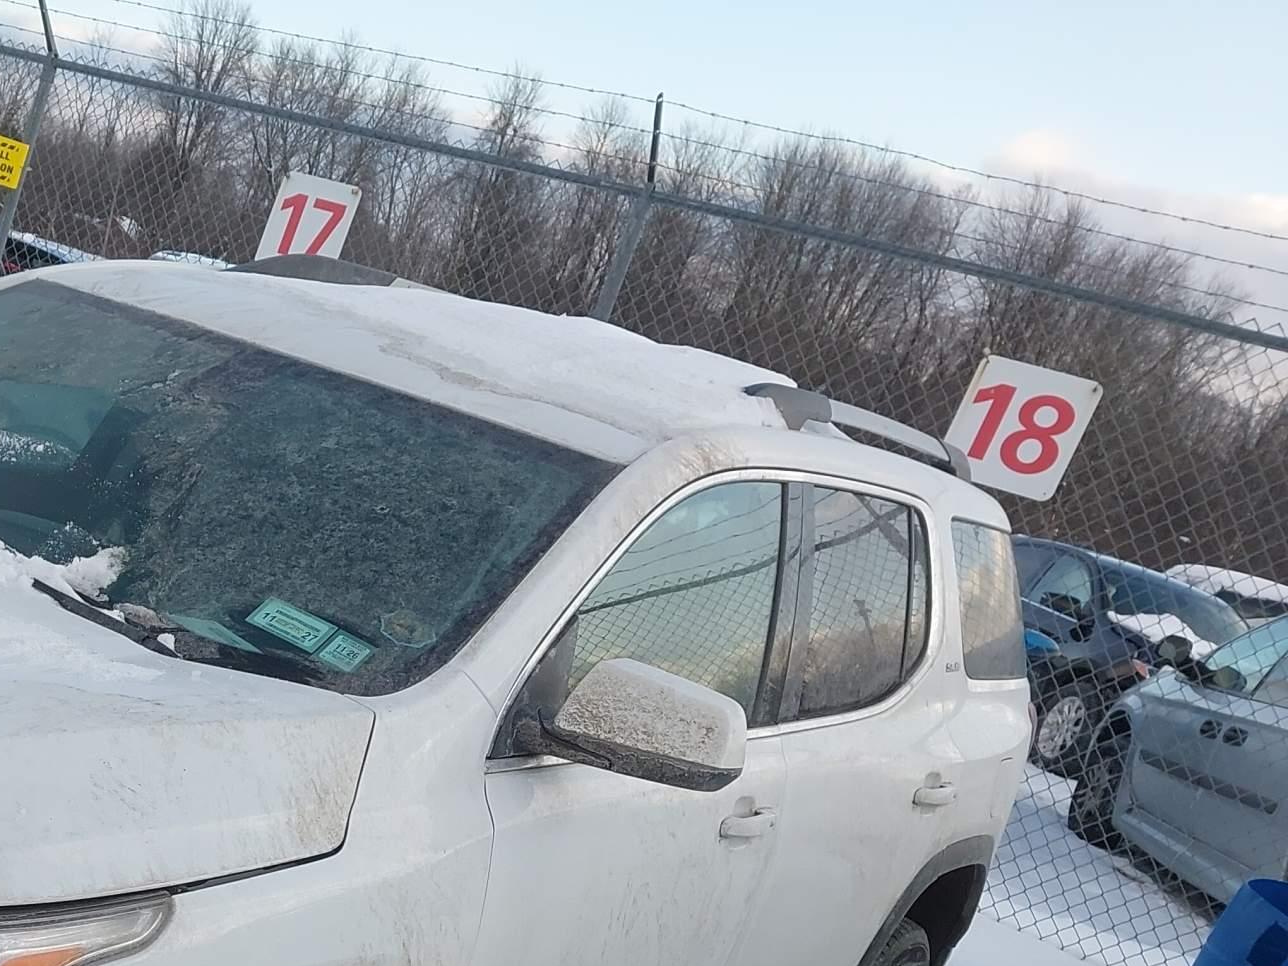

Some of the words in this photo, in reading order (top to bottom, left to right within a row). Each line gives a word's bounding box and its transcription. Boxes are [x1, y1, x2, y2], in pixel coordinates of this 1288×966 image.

[277, 193, 347, 256] 17
[966, 383, 1076, 475] 18
[301, 631, 319, 642] 27
